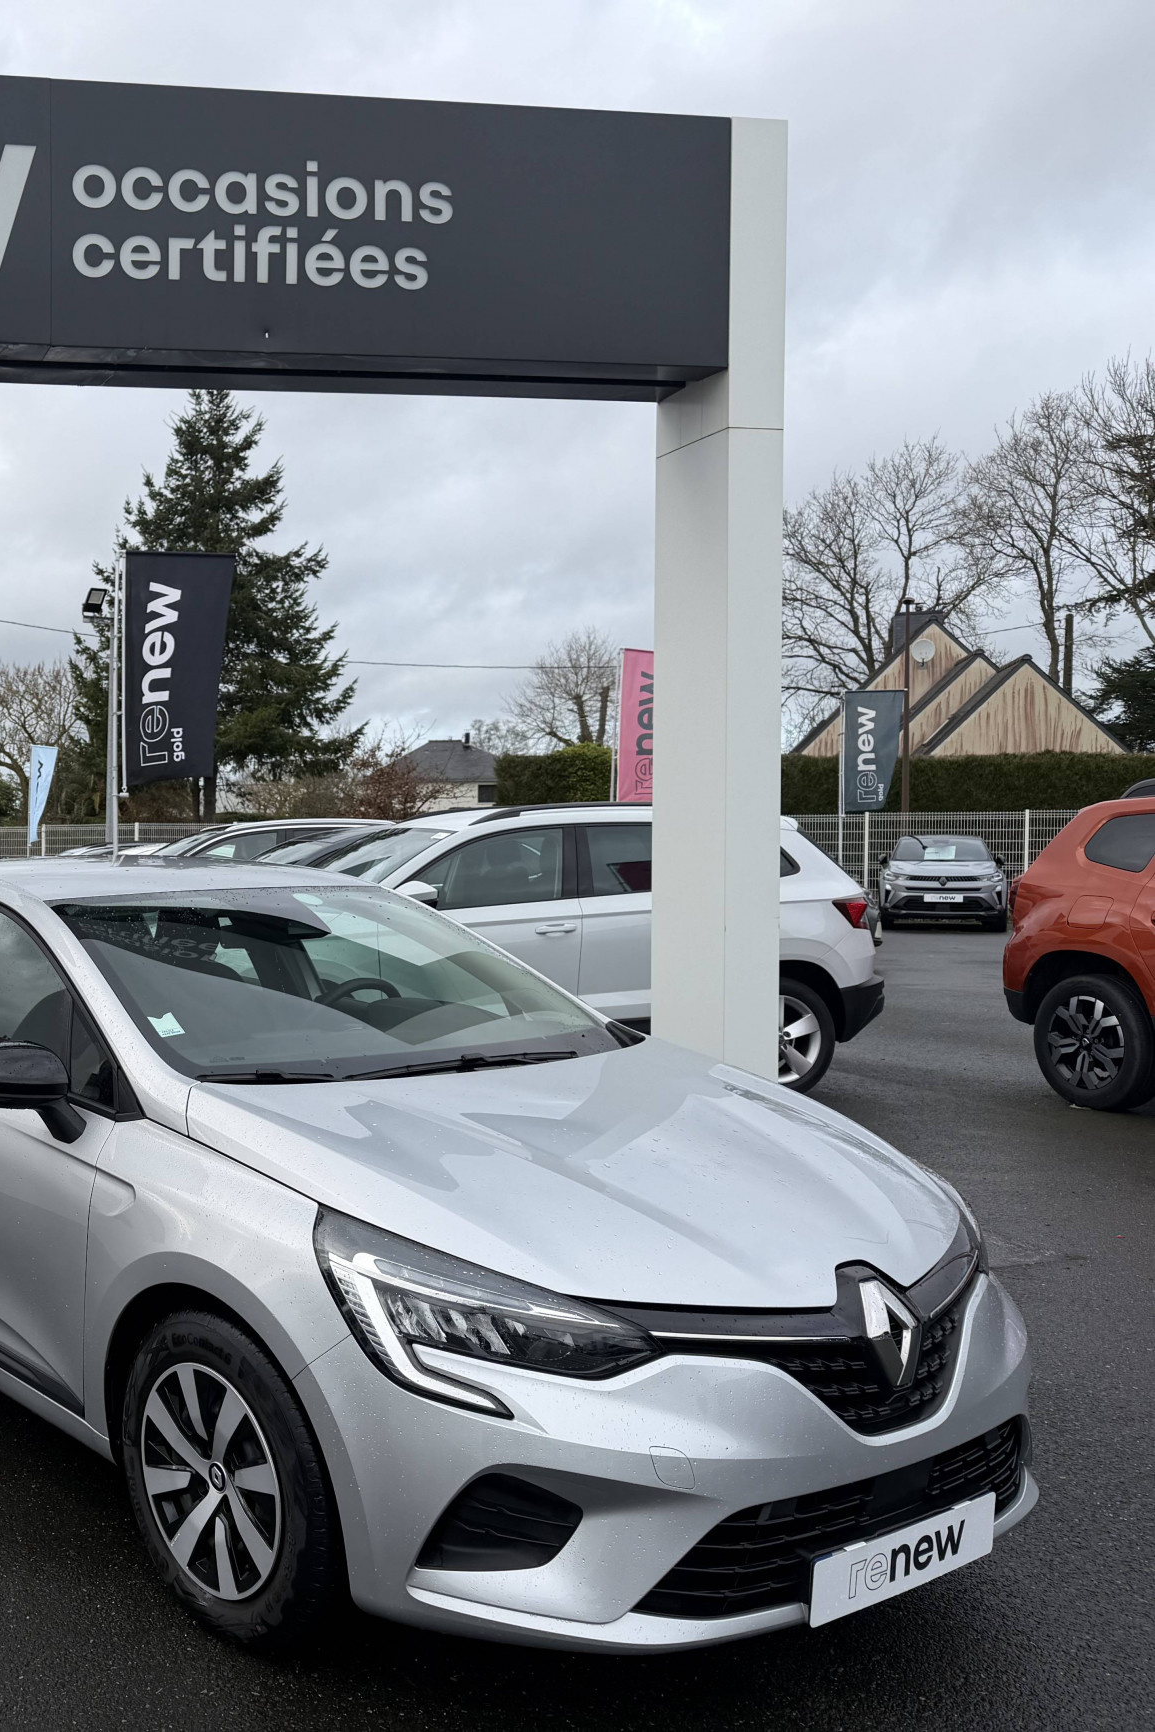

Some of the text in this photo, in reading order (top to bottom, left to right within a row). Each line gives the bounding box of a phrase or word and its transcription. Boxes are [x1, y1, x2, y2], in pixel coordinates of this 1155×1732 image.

[72, 160, 454, 225] occasions
[72, 224, 429, 290] certifiées
[139, 581, 183, 767] renew
[171, 727, 185, 762] gold
[856, 706, 877, 803] renew
[848, 1519, 966, 1600] renew
